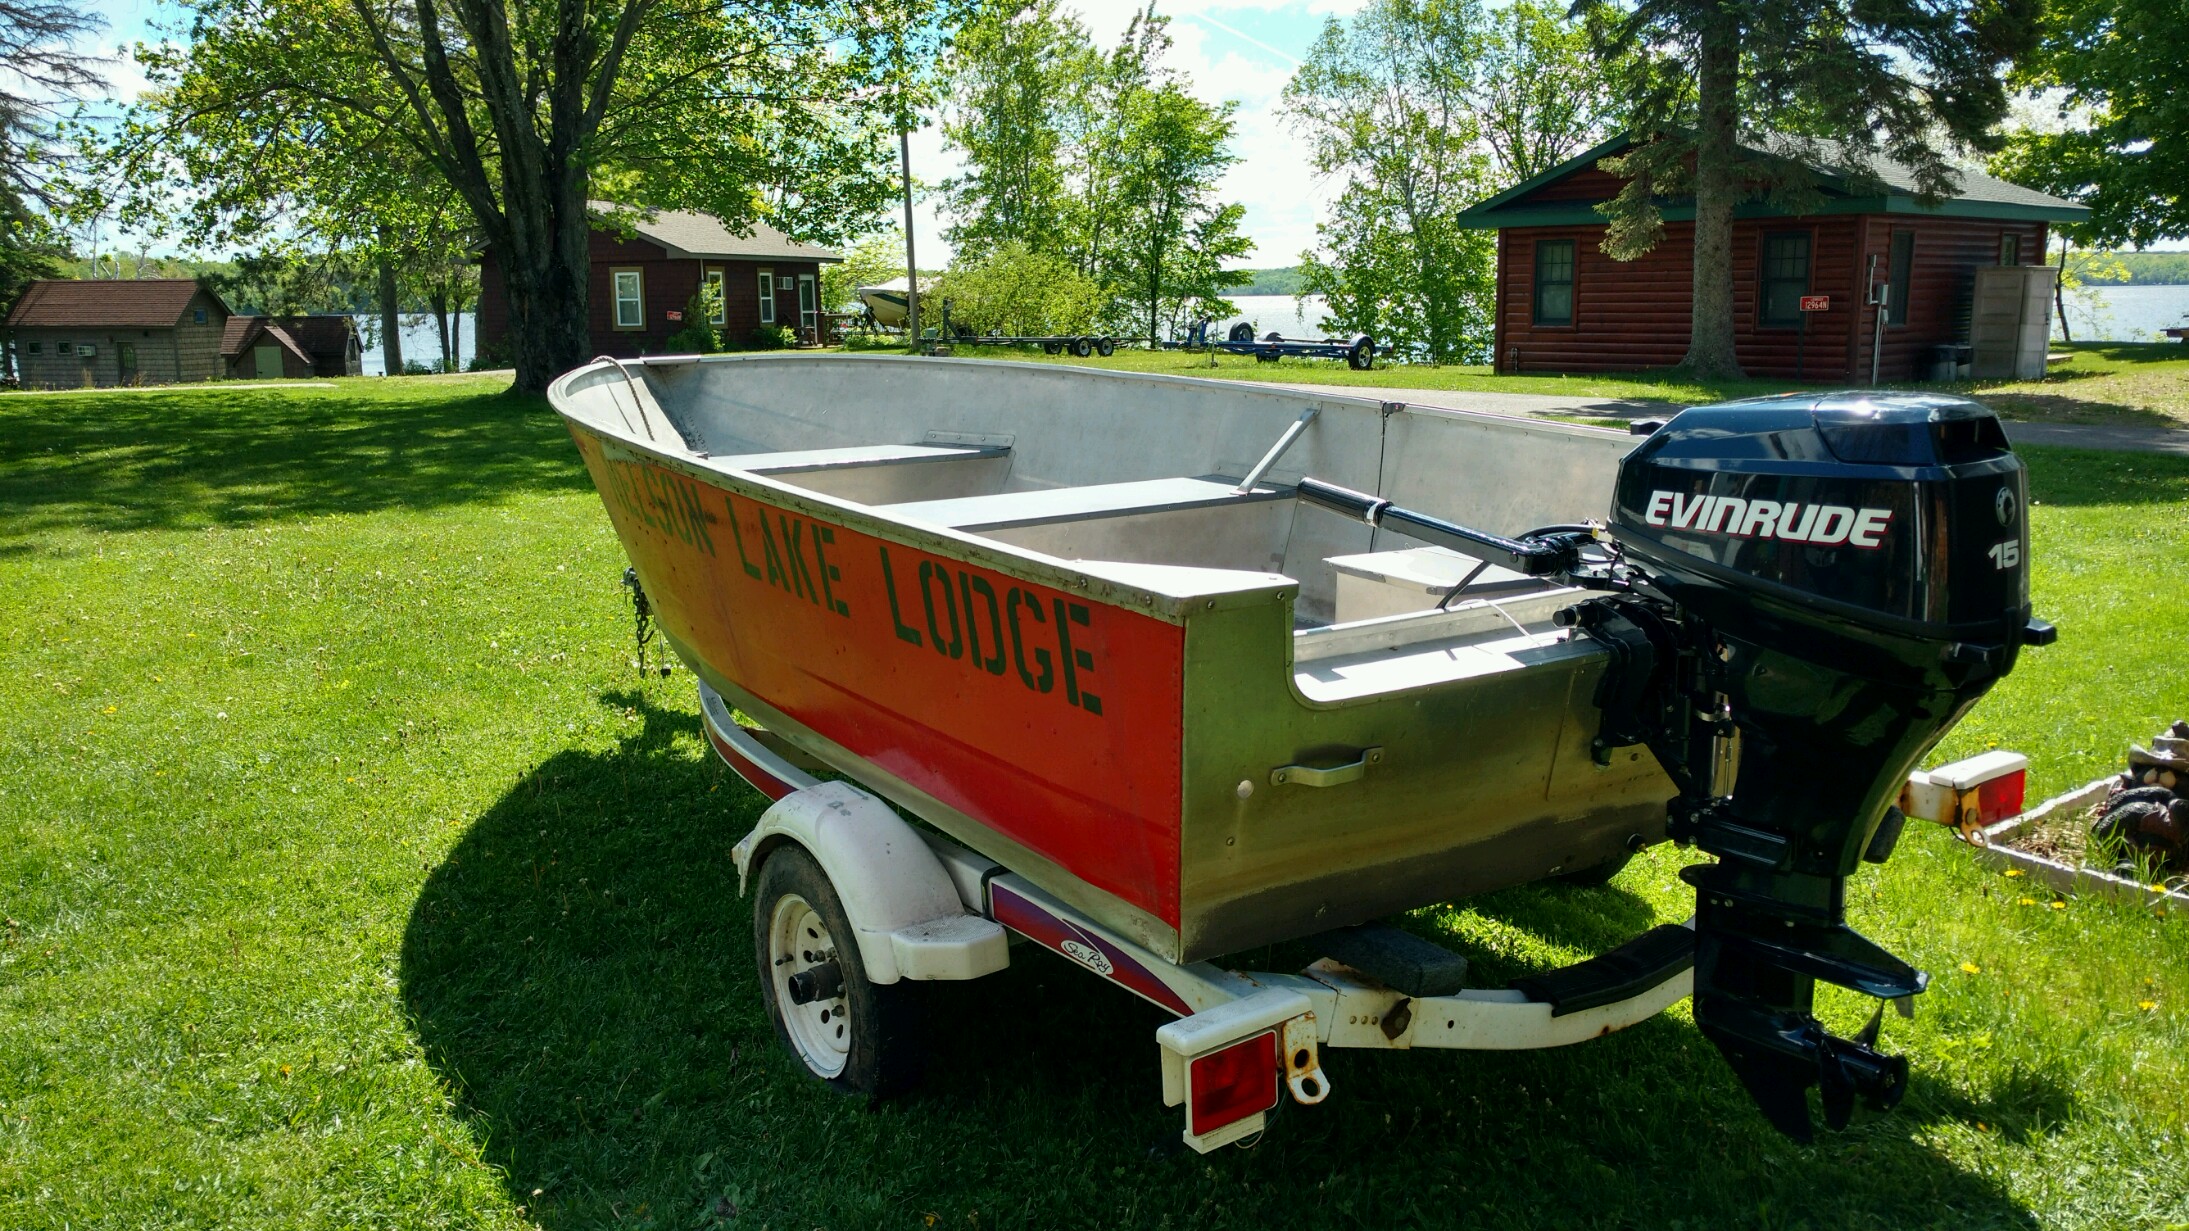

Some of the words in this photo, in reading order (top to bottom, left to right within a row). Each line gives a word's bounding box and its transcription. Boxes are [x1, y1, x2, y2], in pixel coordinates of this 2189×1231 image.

[1645, 490, 1894, 550] EVINRUDE
[1988, 539, 2020, 570] 15
[725, 495, 850, 618] LAKE
[879, 546, 1103, 717] LODGE
[1063, 942, 1087, 960] Sea
[1087, 951, 1111, 973] Ray
